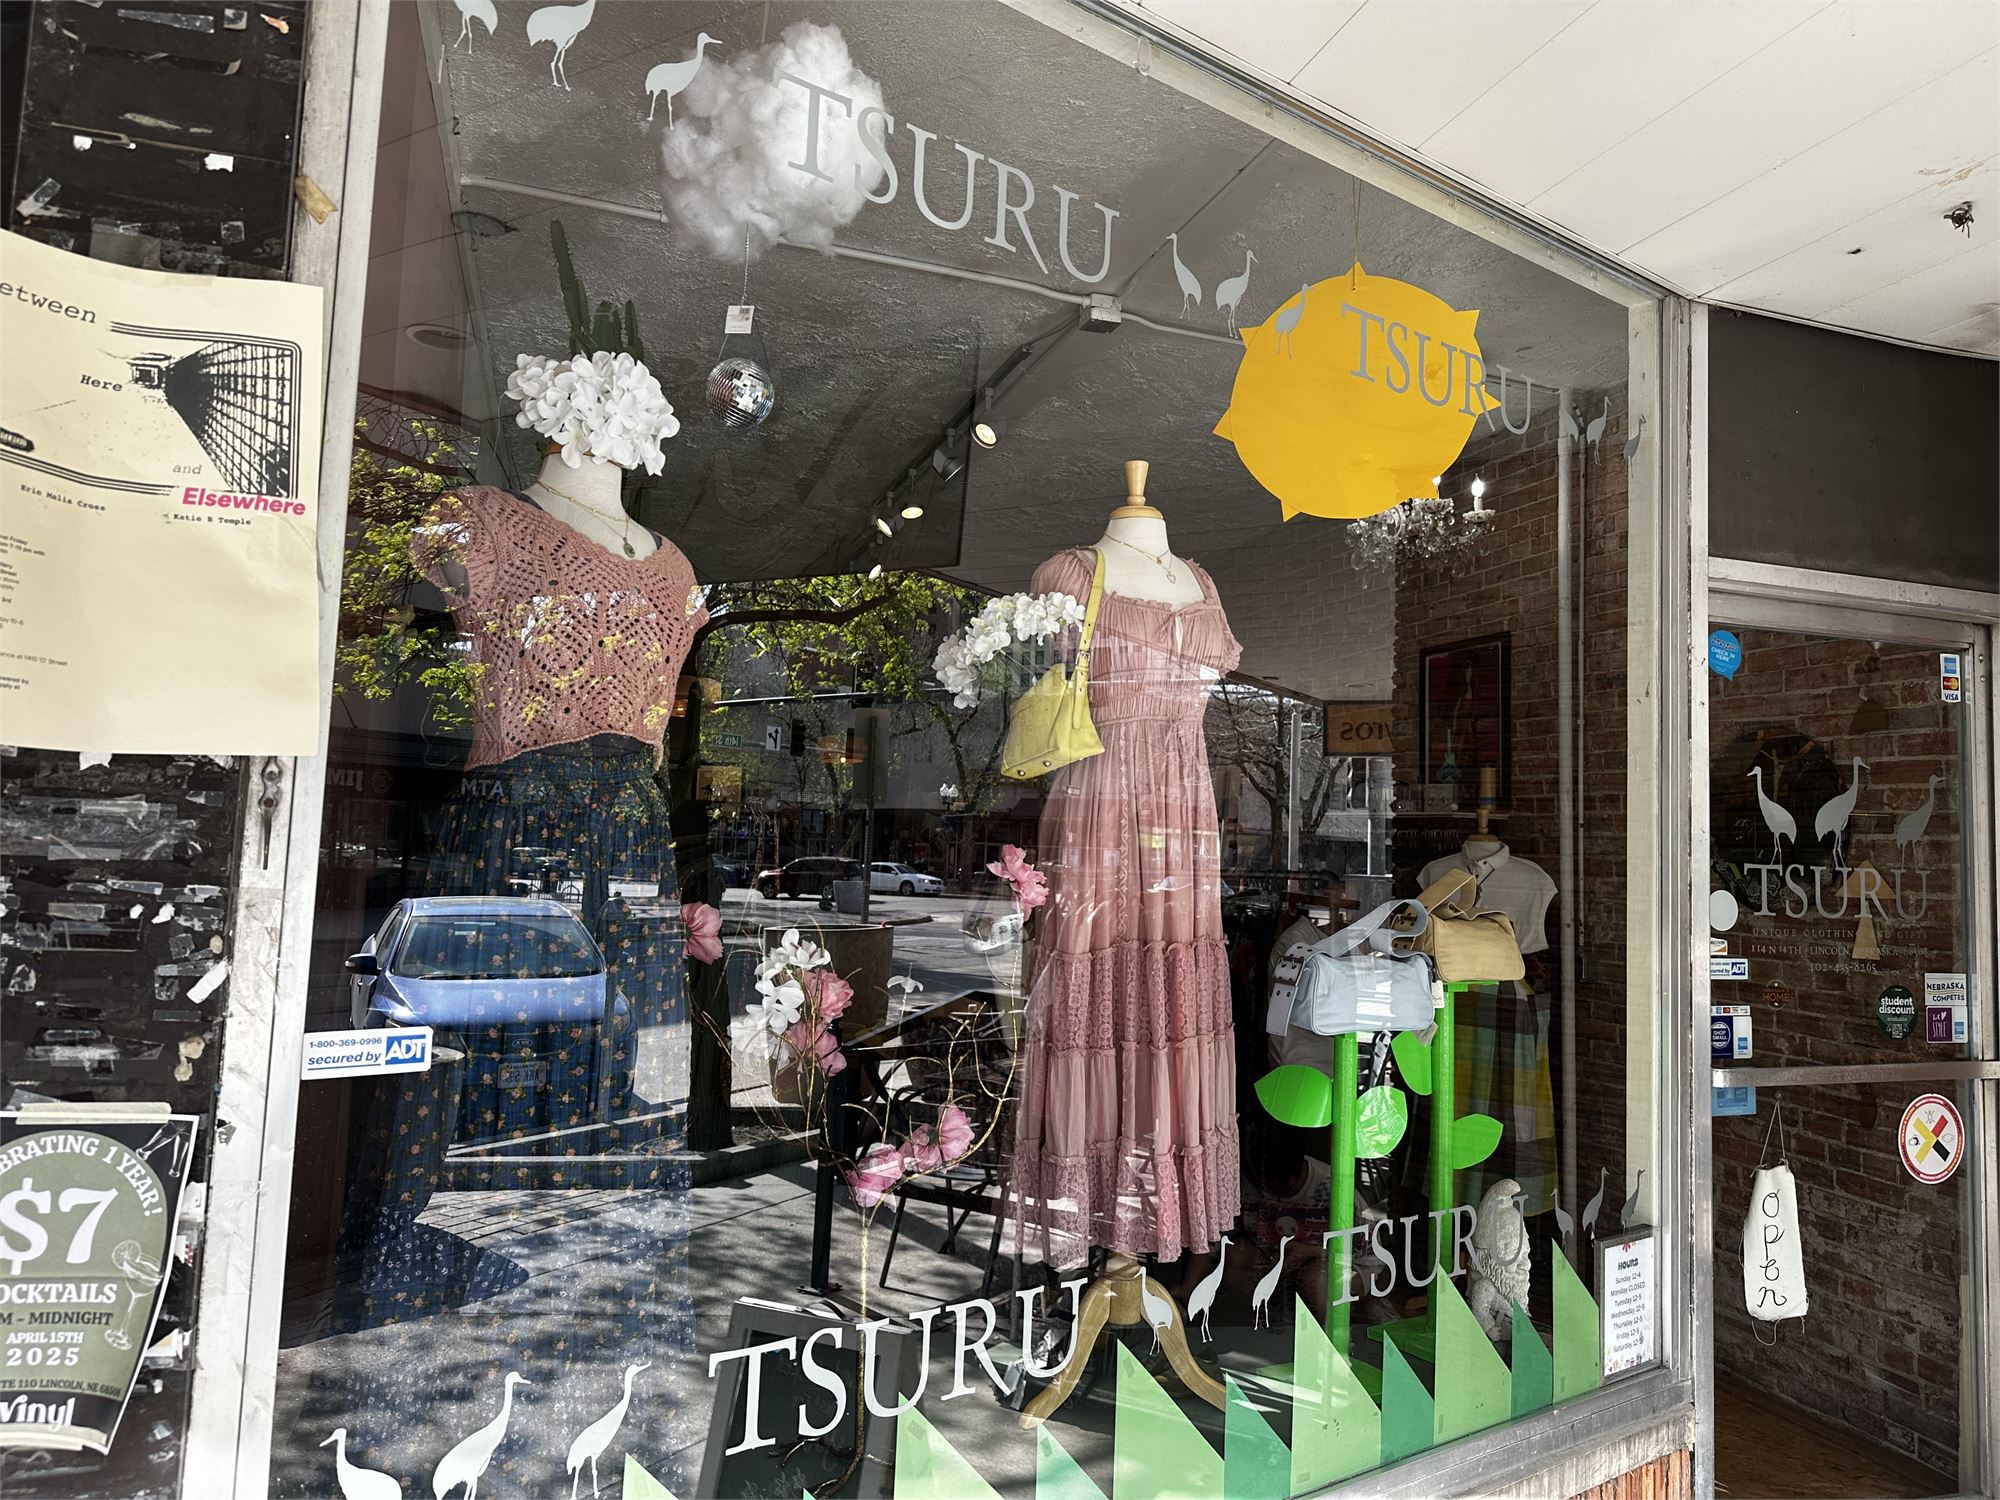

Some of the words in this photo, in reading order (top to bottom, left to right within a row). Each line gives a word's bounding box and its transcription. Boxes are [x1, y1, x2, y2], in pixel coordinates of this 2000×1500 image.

[773, 67, 1120, 283] TSURU
[0, 281, 96, 323] etween
[1341, 303, 1536, 435] TSURU
[80, 374, 123, 392] Here
[173, 465, 202, 475] and
[21, 484, 42, 496] Erin
[77, 501, 106, 511] Cross
[182, 487, 306, 516] Elsewhere
[174, 513, 202, 521] Katie
[218, 517, 251, 526] Temple
[1944, 693, 1959, 701] VISA
[1743, 863, 1931, 923] TSURU
[1752, 928, 1797, 938] UNIQUE
[1803, 928, 1861, 939] CLOTHIN
[1897, 930, 1928, 940] GIFTS
[1768, 945, 1776, 954] N
[1732, 963, 1745, 974] ADT
[1926, 982, 1965, 991] NEBRASKA
[1762, 992, 1790, 1001] HOME
[1880, 996, 1913, 1005] student
[1932, 994, 1965, 1002] COMPETES
[1878, 1005, 1915, 1014] discount
[309, 1037, 382, 1049] 1-800-369-0996
[308, 1052, 363, 1066] secured
[365, 1051, 382, 1063] by
[385, 1038, 426, 1062] ADT
[102, 1146, 118, 1164] 1
[116, 1152, 163, 1217] YEAR!
[0, 1177, 119, 1276] $7
[1323, 1194, 1529, 1306] TSURU
[1618, 1258, 1639, 1270] HOURS
[1615, 1275, 1632, 1284] Sunday
[1632, 1271, 1641, 1280] 12-4
[1610, 1287, 1627, 1297] Monday
[1628, 1281, 1646, 1292] CLOSED
[1614, 1297, 1632, 1307] Tuesday
[1632, 1293, 1642, 1302] 12-5
[1610, 1307, 1635, 1319] Wednesday
[1636, 1303, 1645, 1312] 12-5
[28, 1311, 114, 1326] MIDNIGHT
[1613, 1319, 1633, 1330] Thursday
[1633, 1315, 1642, 1324] 12-5
[6, 1332, 47, 1344] APRIL
[51, 1331, 84, 1344] 15TH
[1616, 1331, 1630, 1341] Friday
[1630, 1327, 1639, 1336] 12-5
[1613, 1342, 1633, 1353] Saturday
[6, 1347, 80, 1366] 2025
[708, 1277, 1088, 1456] TSURU
[18, 1379, 37, 1388] 110
[39, 1379, 85, 1392] LINCOLN,
[87, 1382, 99, 1392] NE
